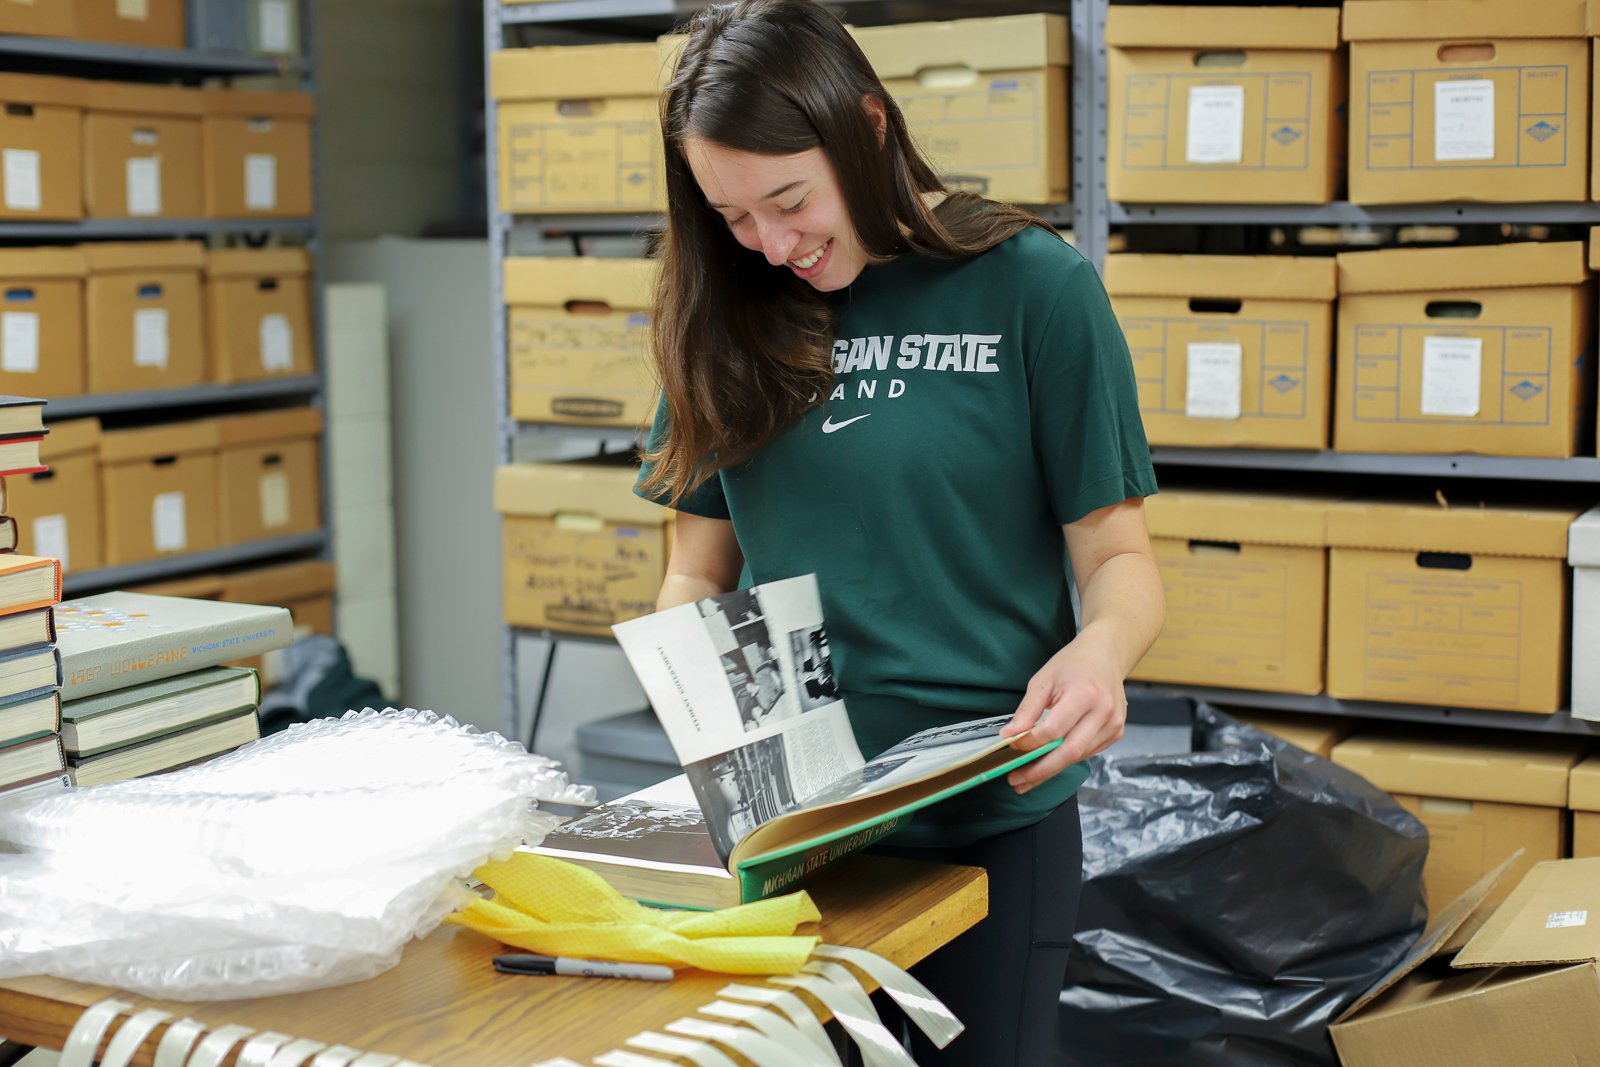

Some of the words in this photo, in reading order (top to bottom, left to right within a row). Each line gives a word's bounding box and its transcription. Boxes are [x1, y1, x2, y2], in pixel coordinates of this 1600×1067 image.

[896, 334, 1002, 373] STATE
[808, 379, 906, 403] AND
[192, 642, 220, 654] MICHIGAN
[222, 636, 240, 648] STATE
[242, 628, 276, 642] UNIVERSITY
[71, 664, 103, 686] 1967
[762, 863, 804, 896] MICHIGAN
[805, 850, 828, 874] STATE
[829, 828, 873, 862] UNIVERSITY
